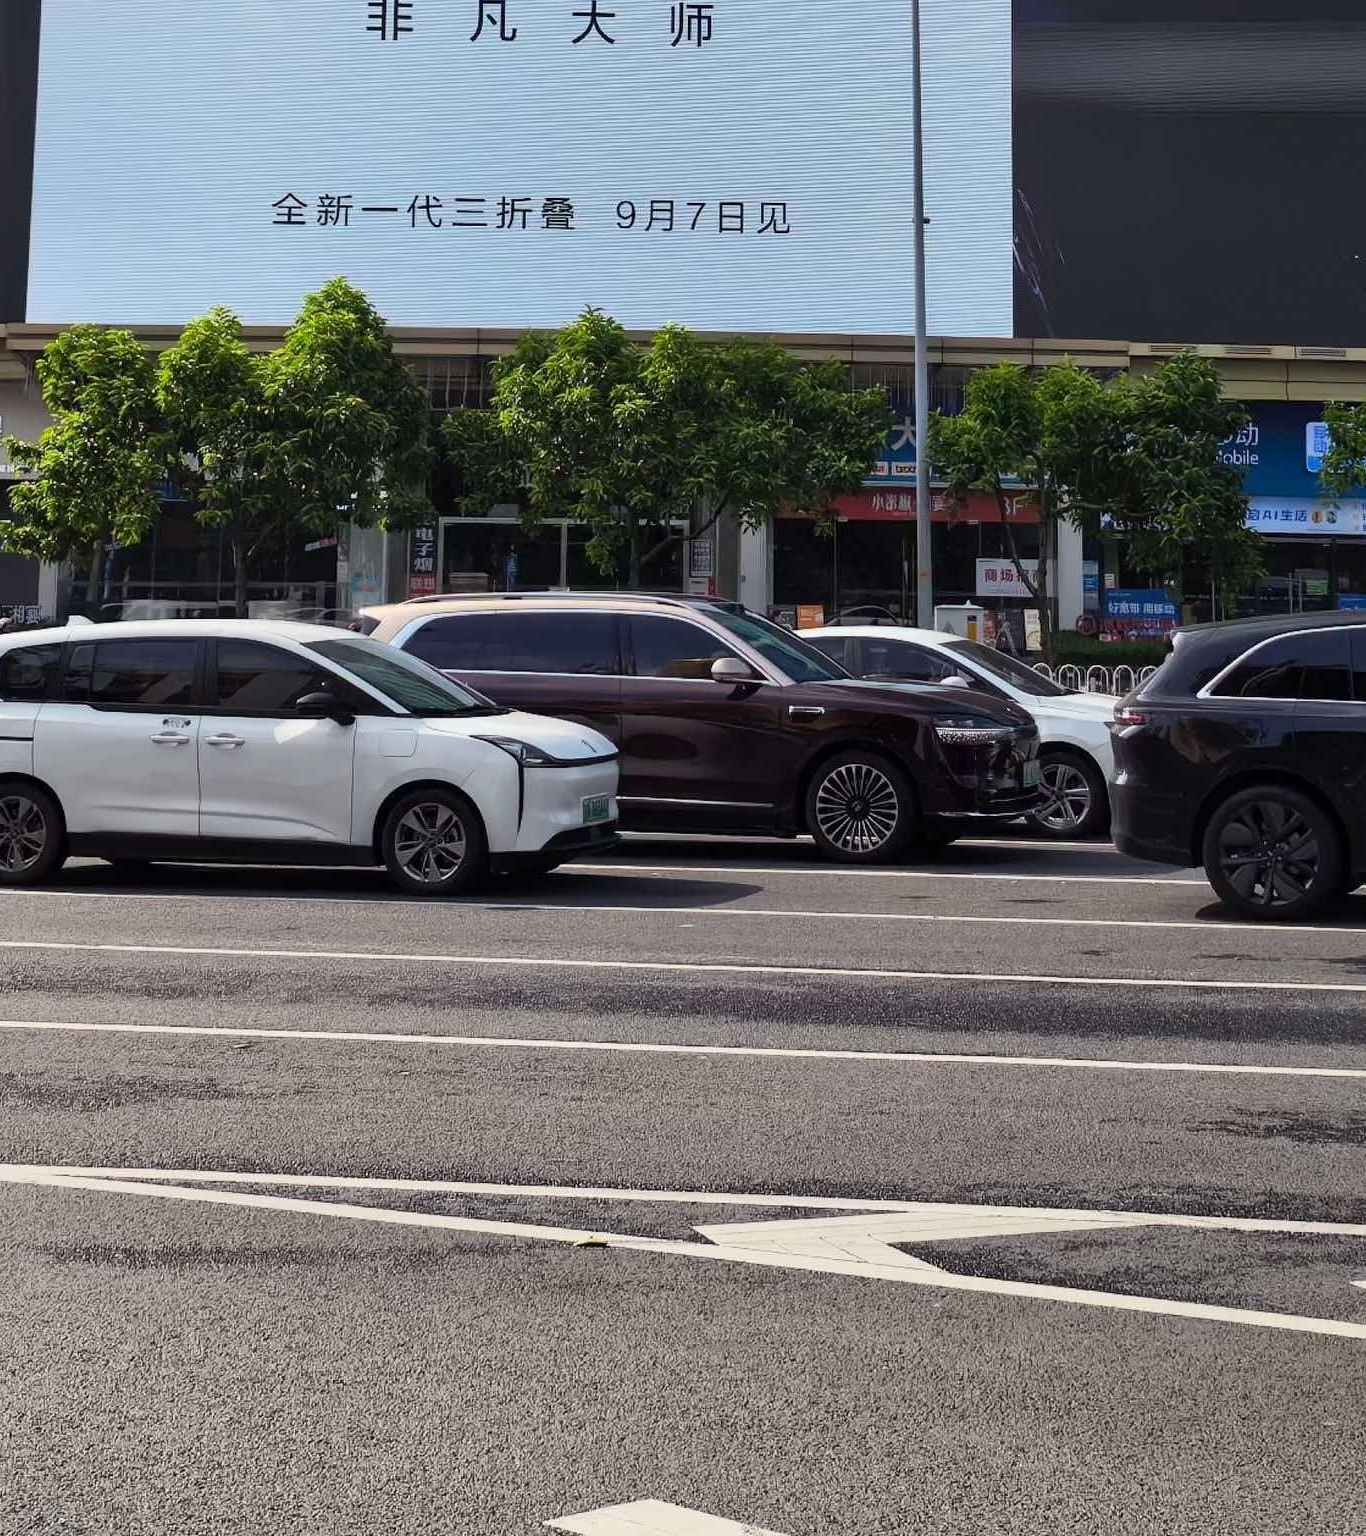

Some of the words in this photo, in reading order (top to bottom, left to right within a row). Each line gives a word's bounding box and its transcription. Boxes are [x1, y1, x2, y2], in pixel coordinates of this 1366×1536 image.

[270, 191, 577, 231] 全新一代三折叠
[615, 198, 792, 235] 9月7日见
